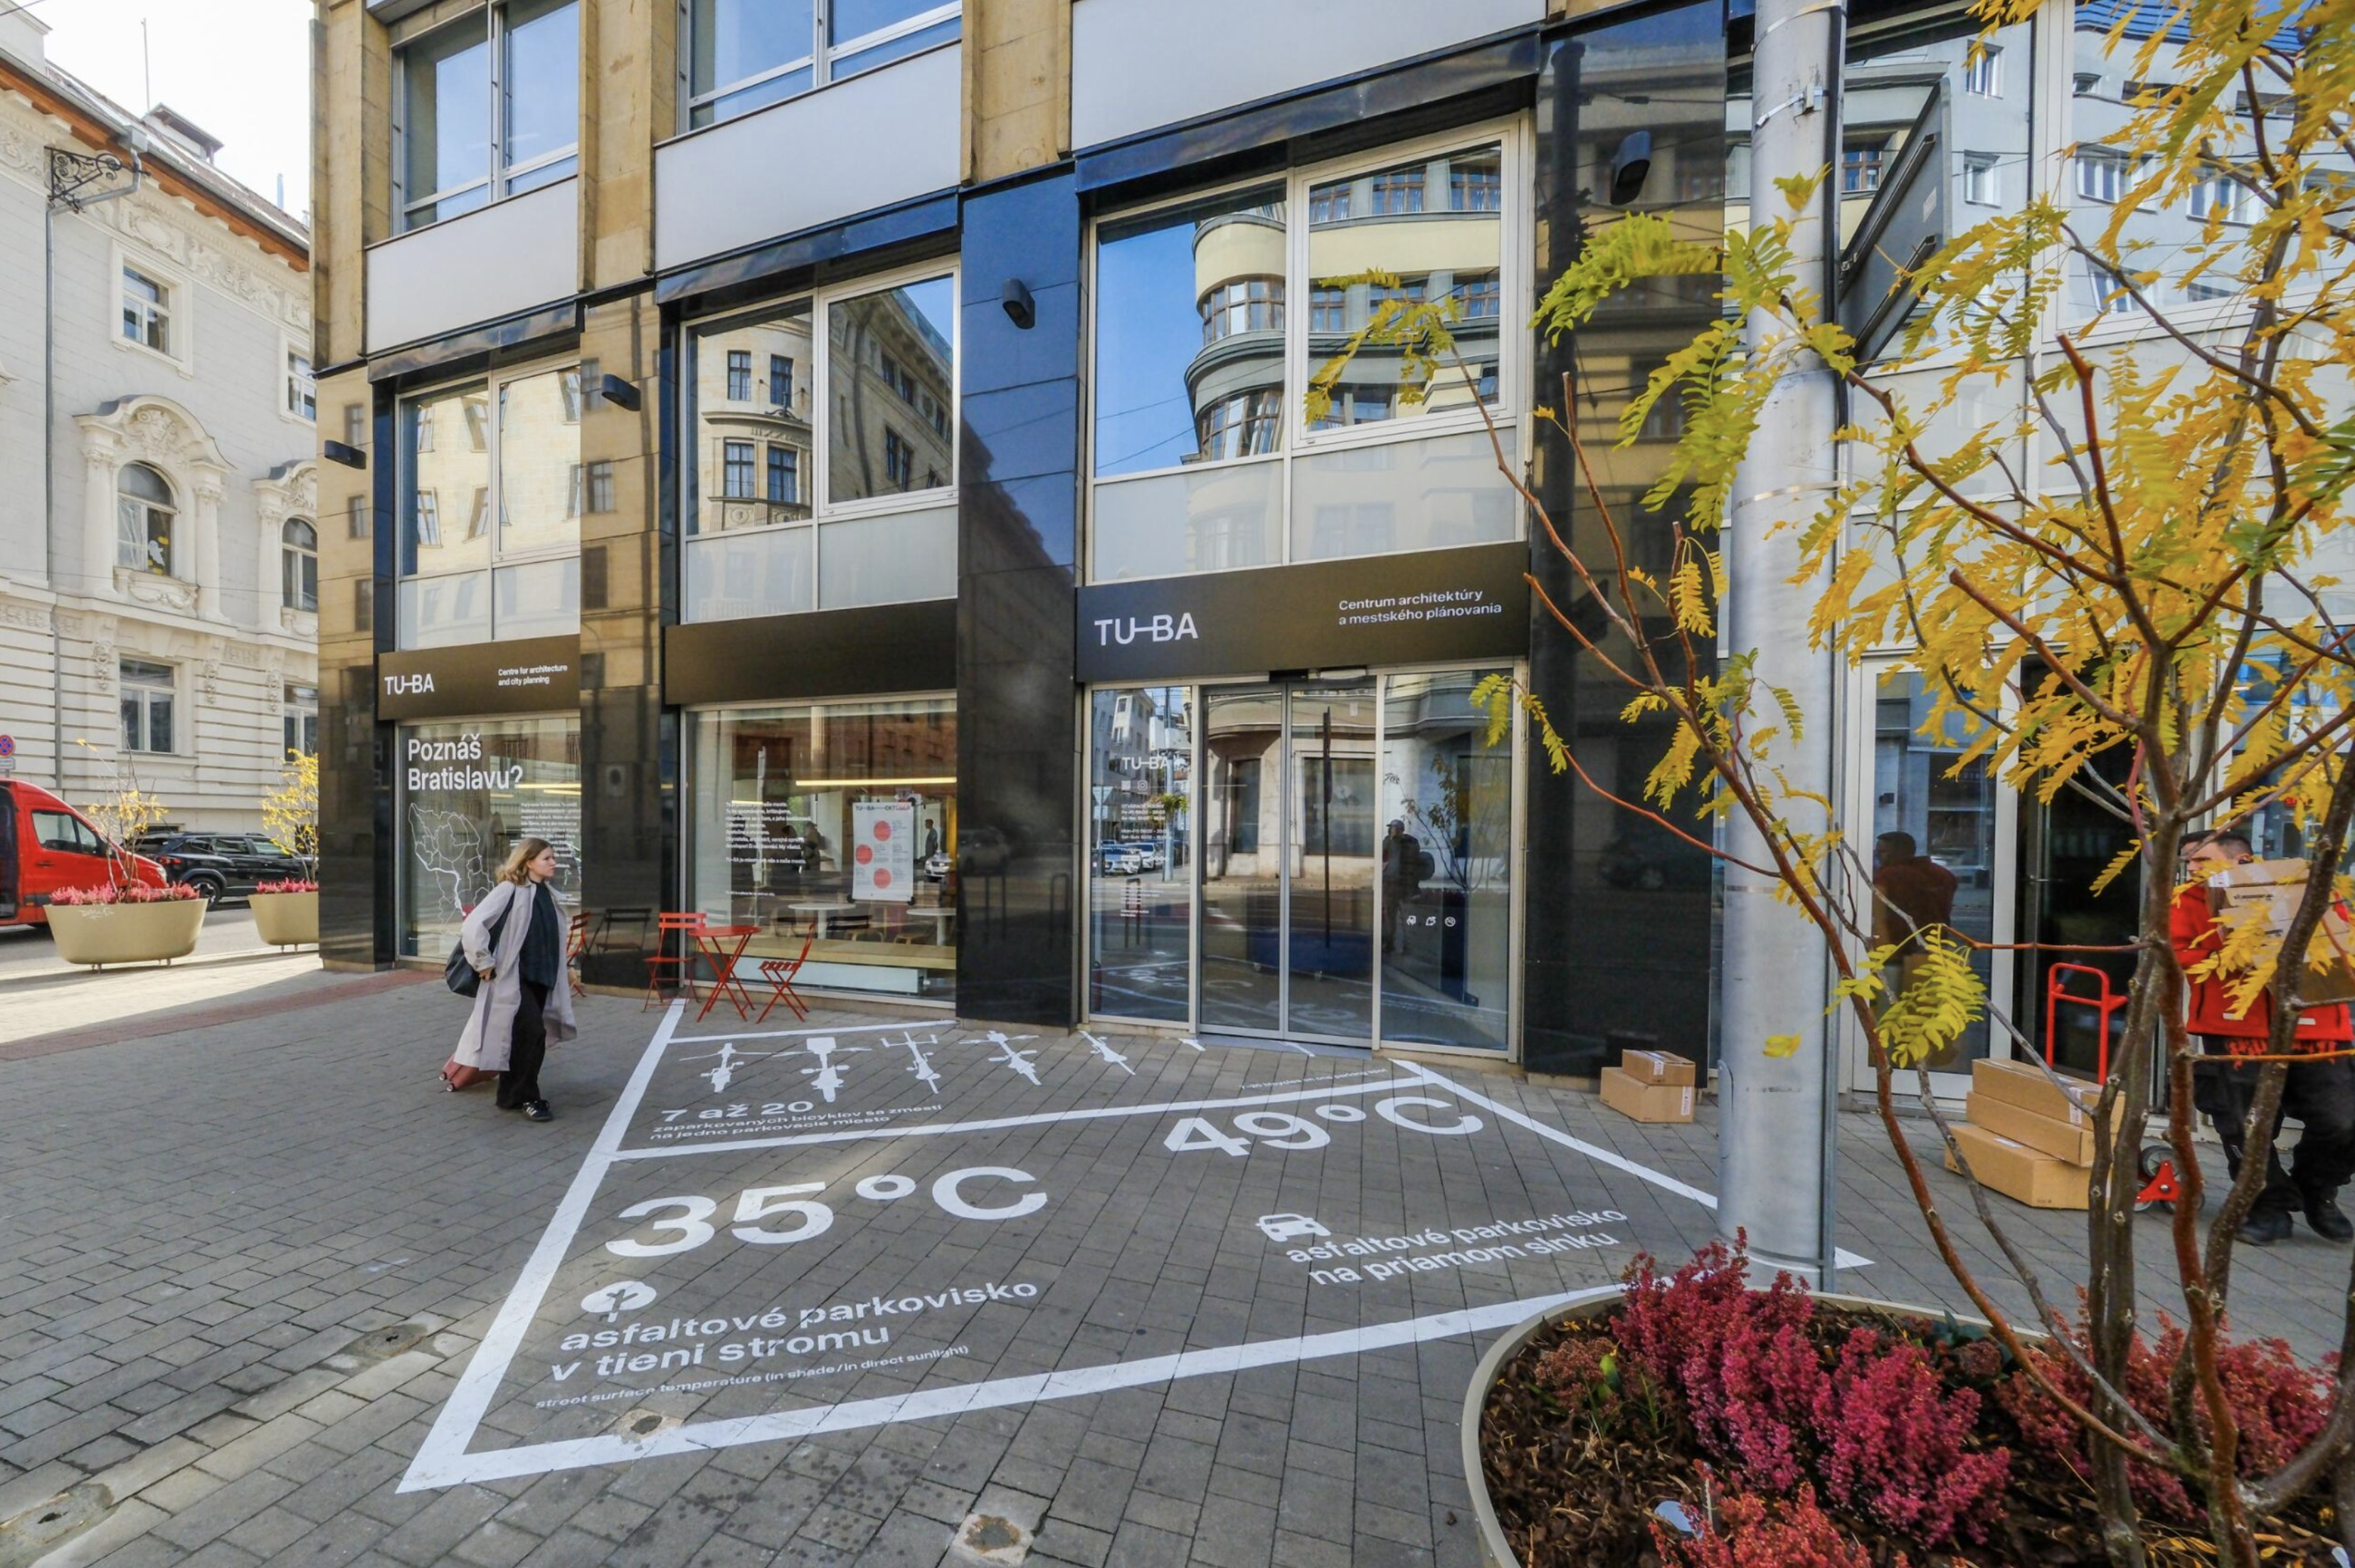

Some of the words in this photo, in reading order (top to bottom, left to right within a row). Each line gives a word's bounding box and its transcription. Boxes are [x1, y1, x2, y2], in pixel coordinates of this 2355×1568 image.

[1339, 598, 1395, 610] Centrum
[1399, 589, 1483, 606] architektúry
[1339, 616, 1347, 625] a
[1349, 607, 1423, 624] mestského
[1426, 603, 1502, 620] plánovania
[511, 677, 522, 686] city
[523, 676, 550, 685] planning
[529, 664, 568, 674] architecture
[408, 733, 482, 761] Poznáš
[408, 764, 523, 790] Bratislavu?
[652, 1117, 788, 1133] zaparkovaných
[792, 1111, 861, 1122] bicyklov
[889, 1104, 943, 1114] zmestí
[662, 1109, 687, 1122] 7
[698, 1104, 748, 1119] až
[761, 1101, 813, 1115] 20
[676, 1129, 728, 1139] jedno
[732, 1121, 828, 1135] parkovacie
[833, 1116, 890, 1125] miesto
[1286, 1227, 1451, 1263] asfaltové
[1450, 1209, 1628, 1244] parkovisko
[1308, 1266, 1362, 1285] na
[1363, 1241, 1528, 1282] priamom
[1523, 1231, 1620, 1255] slnku
[560, 1306, 787, 1350] asfaltové
[800, 1283, 1037, 1329] parkovisko
[551, 1361, 581, 1381] v
[596, 1343, 705, 1376] tieni
[718, 1328, 889, 1362] stromu
[536, 1394, 587, 1409] street
[591, 1387, 656, 1402] surface
[660, 1374, 762, 1393] temperature
[765, 1372, 784, 1383] (in
[861, 1356, 904, 1370] direct
[907, 1345, 969, 1364] sunlight)
